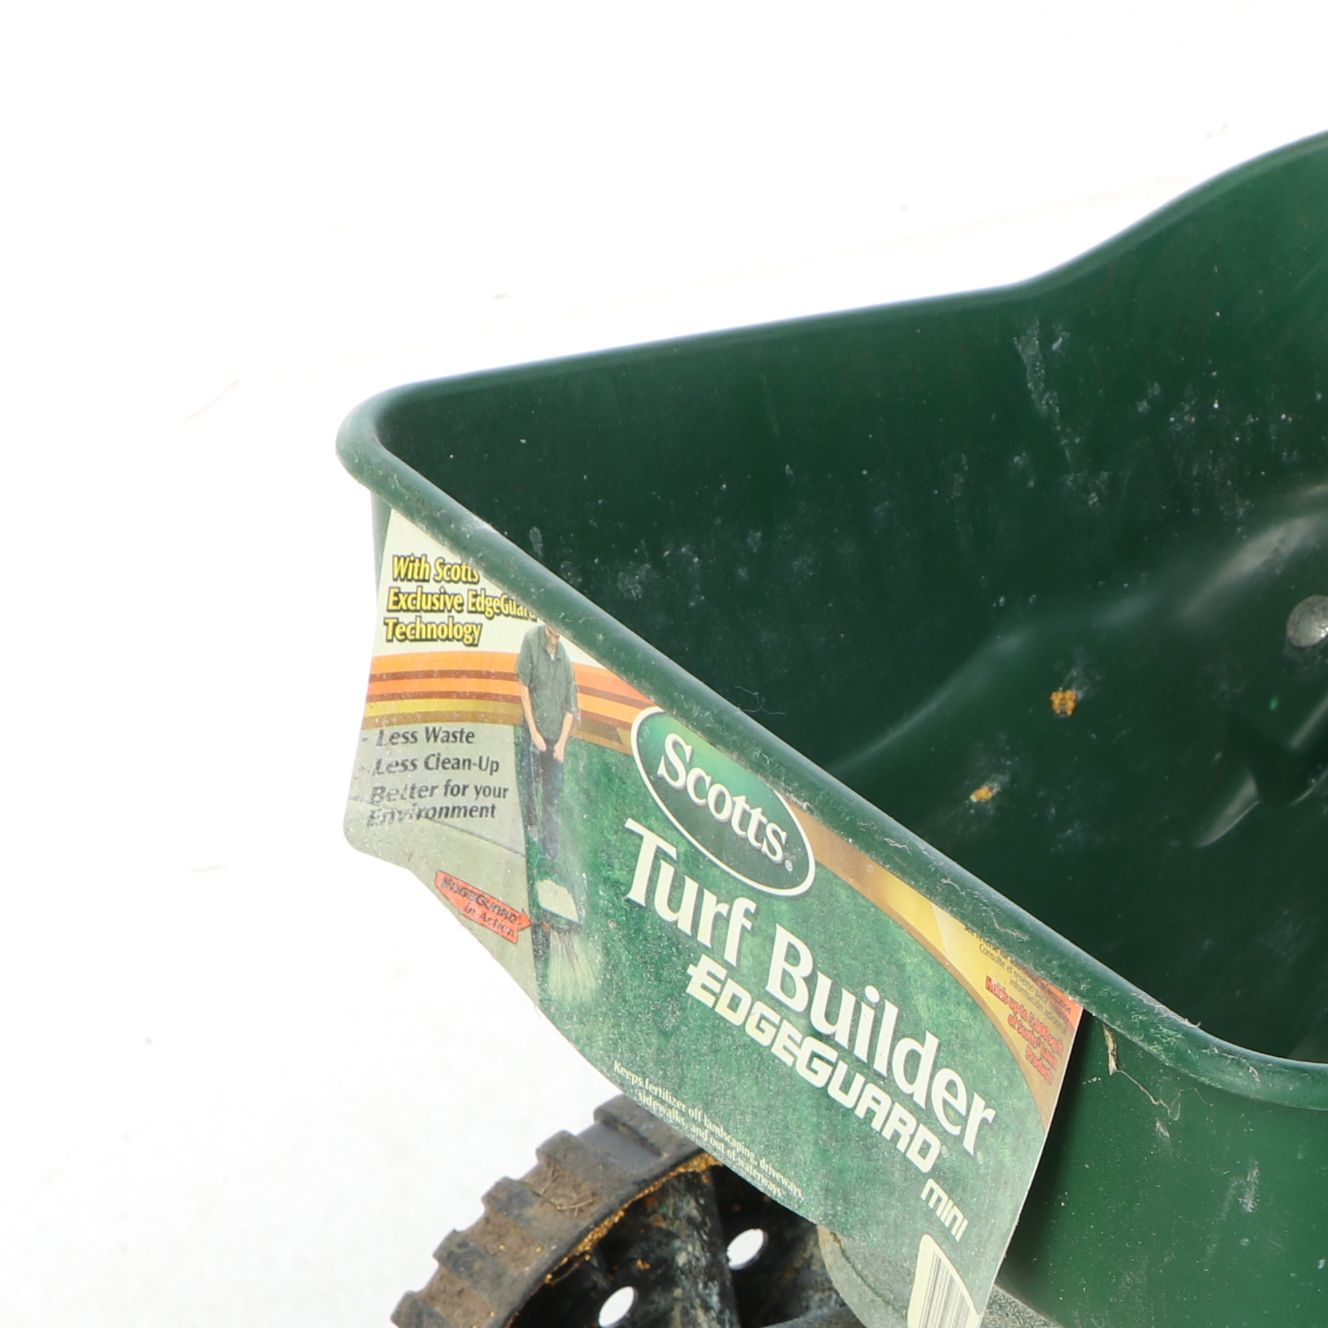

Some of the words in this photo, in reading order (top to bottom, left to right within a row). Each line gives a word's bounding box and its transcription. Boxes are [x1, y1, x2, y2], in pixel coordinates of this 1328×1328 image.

[391, 554, 431, 583] With
[387, 586, 464, 613] Exclusive
[384, 616, 483, 646] Technology
[376, 727, 418, 747] Less
[424, 725, 476, 745] Waste
[373, 756, 418, 776] Less
[424, 753, 500, 776] Clean-Up
[370, 781, 435, 806] Better
[443, 779, 469, 797] for
[474, 784, 509, 804] your
[657, 732, 789, 865] Scotts
[366, 803, 496, 828] Environment
[625, 817, 757, 968] Turf
[764, 923, 997, 1156] Builder
[686, 953, 942, 1174] EDGEGUARD
[644, 1076, 687, 1112] fertilizer
